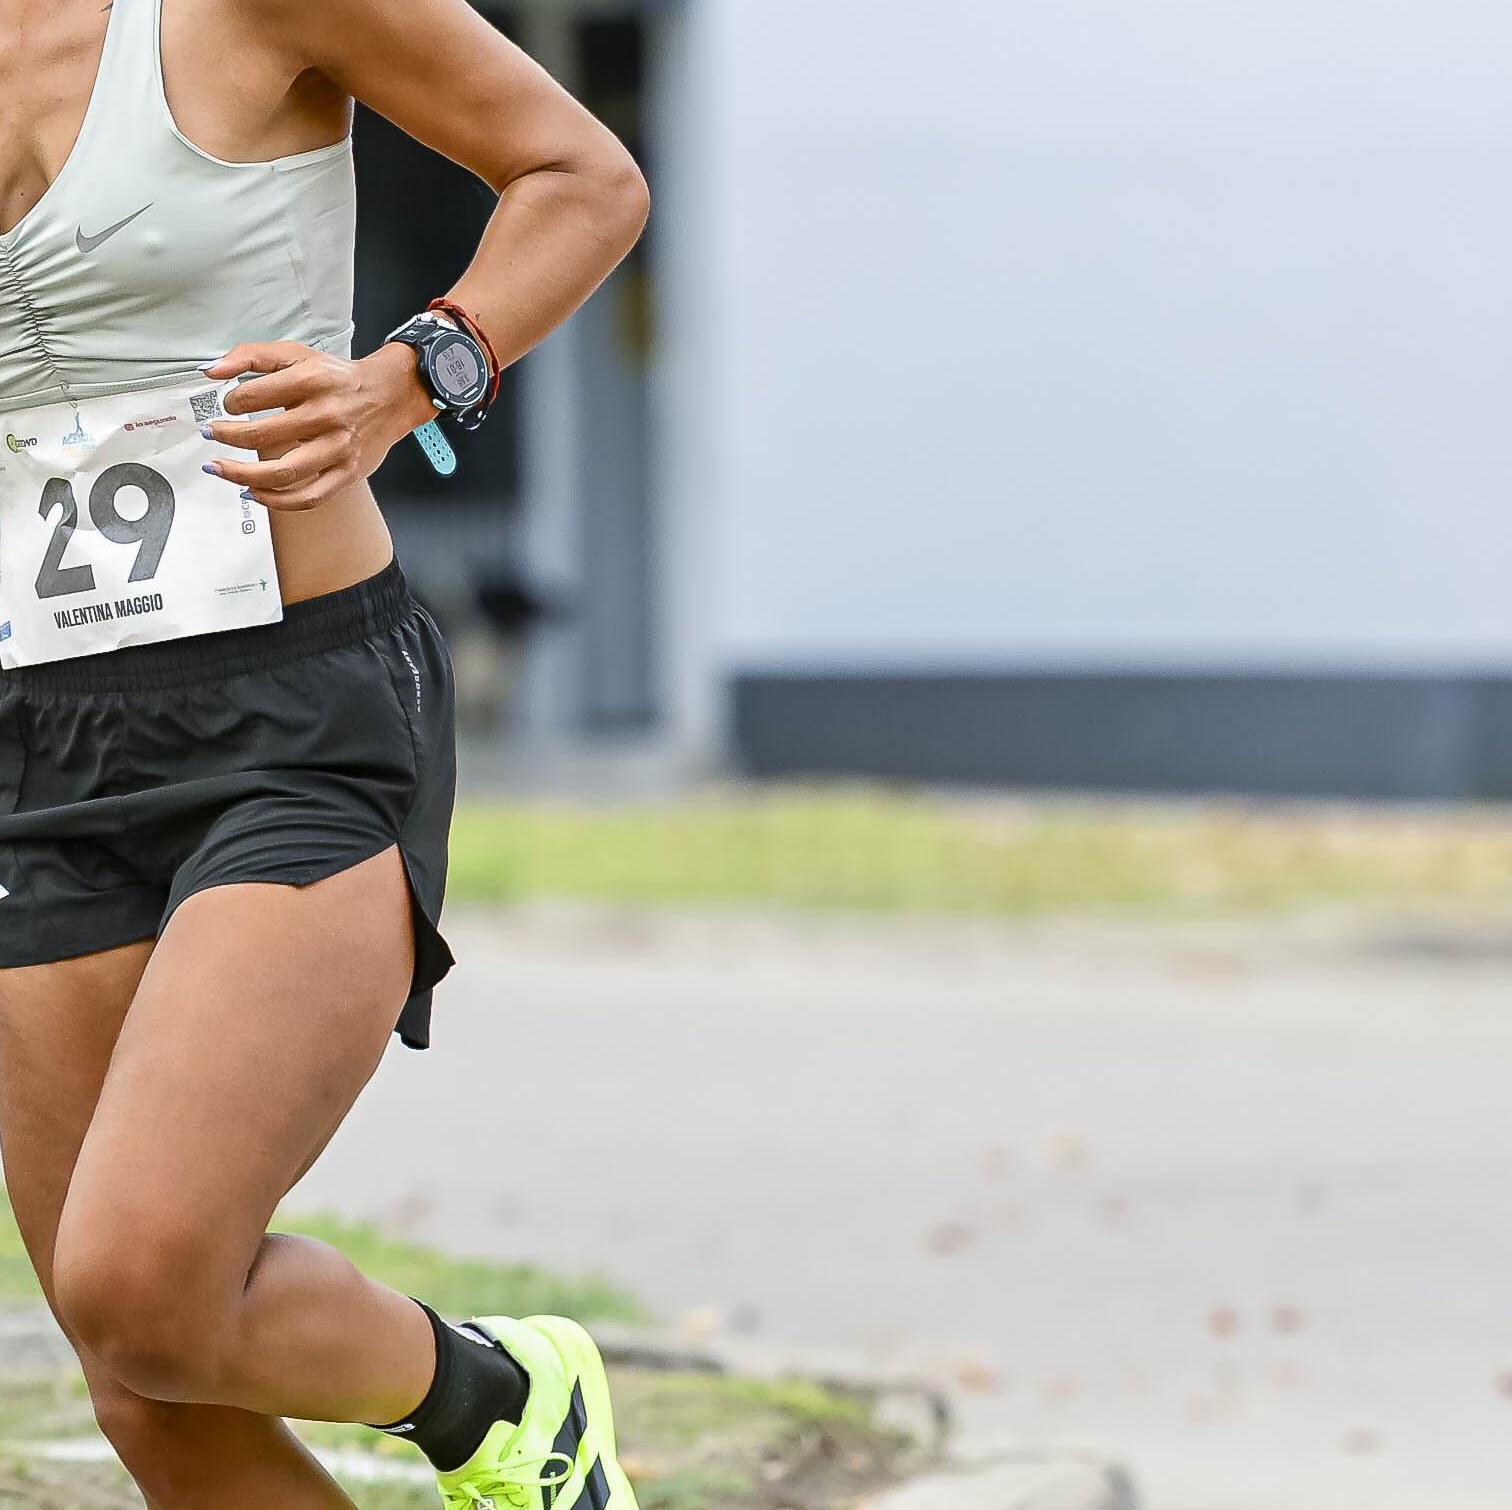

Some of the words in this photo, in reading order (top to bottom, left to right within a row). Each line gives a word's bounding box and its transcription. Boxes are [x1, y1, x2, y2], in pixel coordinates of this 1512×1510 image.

[35, 463, 175, 599] 29
[54, 602, 113, 629] VALENTINA
[114, 593, 163, 618] MAGGIO
